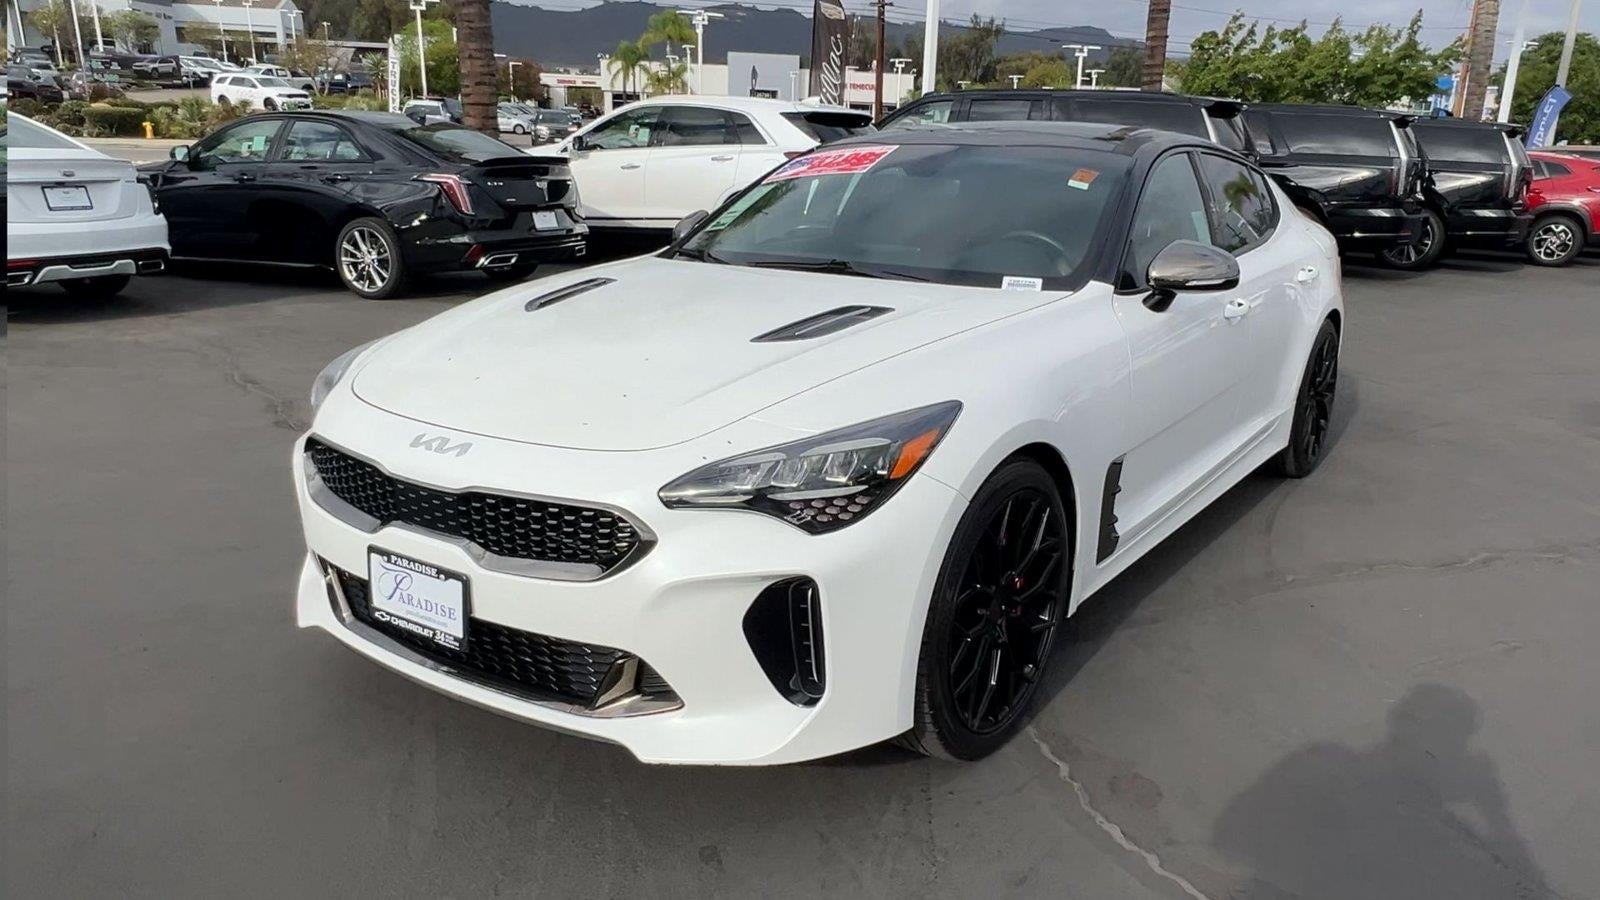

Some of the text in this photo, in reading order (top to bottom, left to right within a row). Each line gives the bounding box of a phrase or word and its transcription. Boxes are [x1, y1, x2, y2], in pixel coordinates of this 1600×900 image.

[819, 33, 843, 105] illac.
[409, 433, 473, 457] KIA
[390, 555, 438, 578] PARADISE
[390, 616, 434, 638] CHEVROLET
